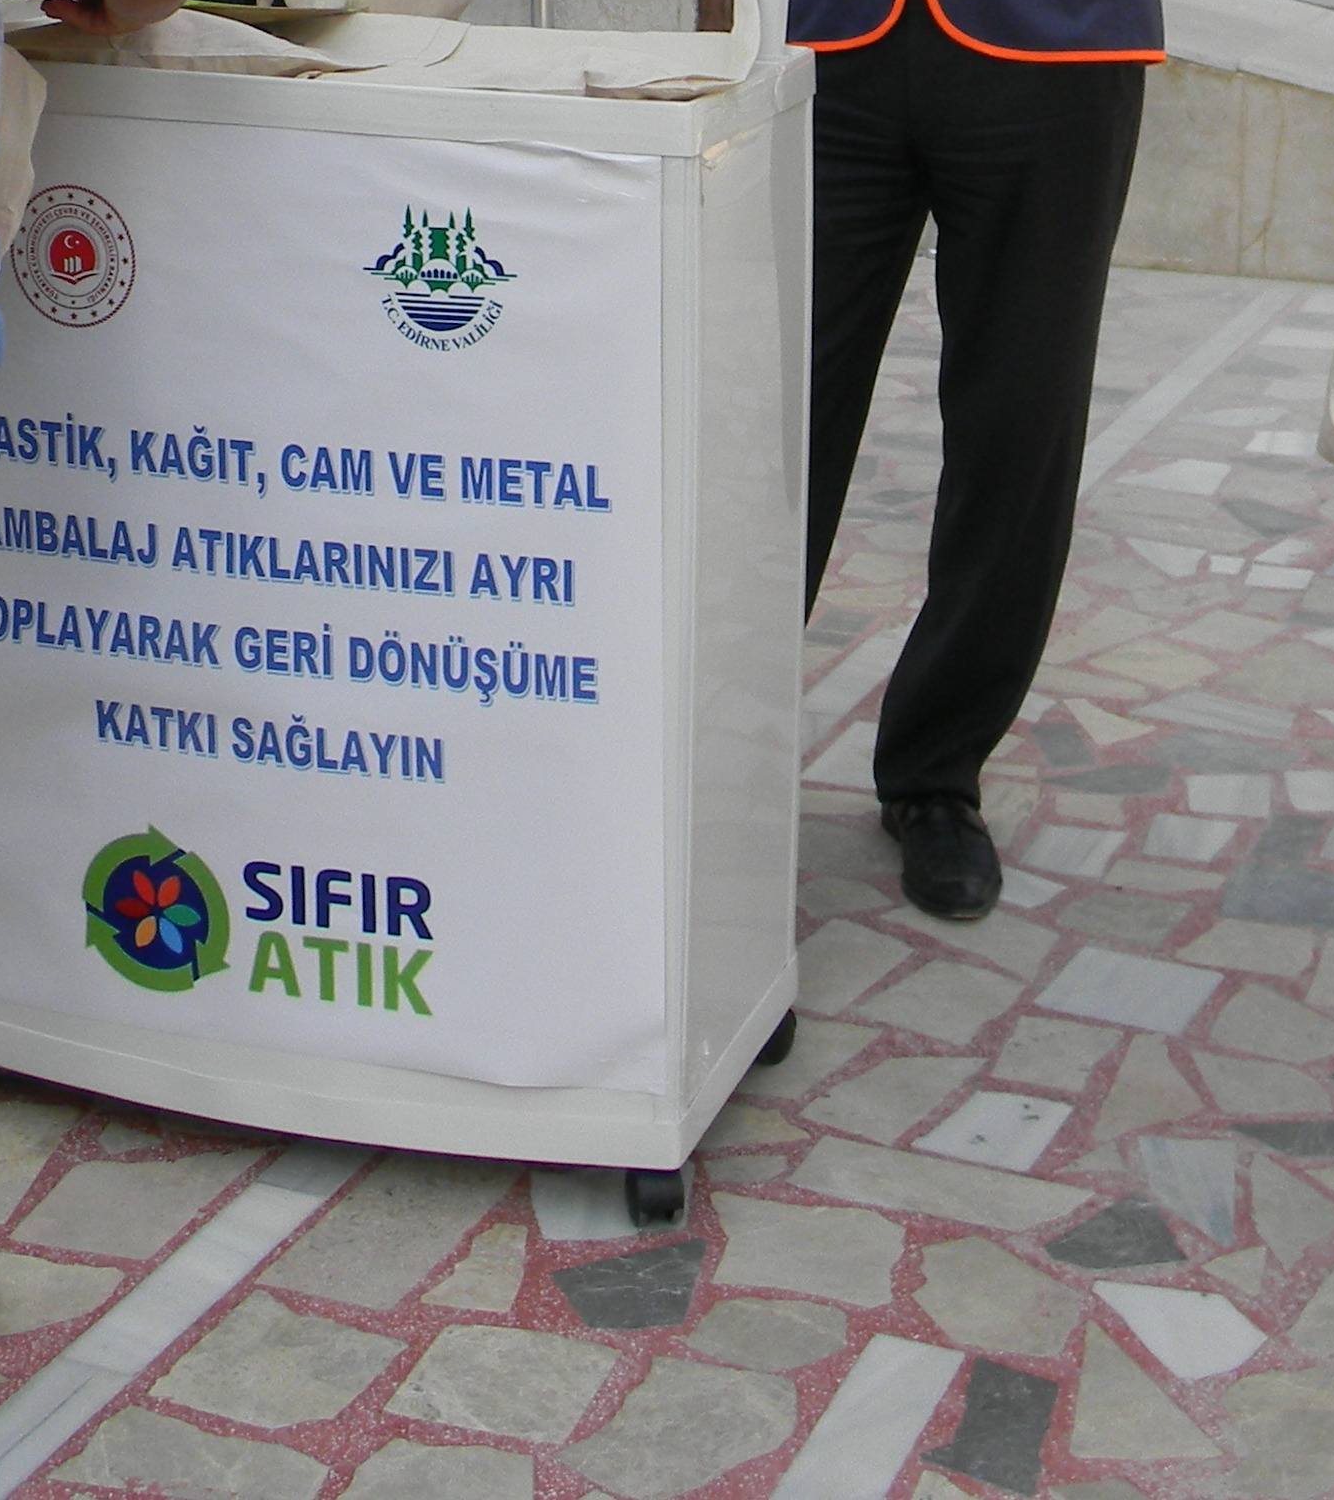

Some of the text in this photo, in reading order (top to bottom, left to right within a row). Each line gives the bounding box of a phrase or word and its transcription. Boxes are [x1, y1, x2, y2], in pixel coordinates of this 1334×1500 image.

[381, 293, 504, 352] T.C. EDİRNE VALİLİĞİ
[129, 425, 266, 497] KAĞIT,
[280, 443, 375, 496] CAM
[388, 451, 446, 499] VE
[460, 456, 612, 513] METAL
[171, 526, 455, 596] ATIKLARINIZI
[469, 552, 575, 607] AYRI
[234, 622, 334, 679] GERİ
[349, 629, 599, 706] DÖNÜŞÜME
[95, 699, 445, 784] KATKI SAĞLAYIN
[243, 860, 434, 941] SIFIR
[247, 930, 434, 1017] ATIK
